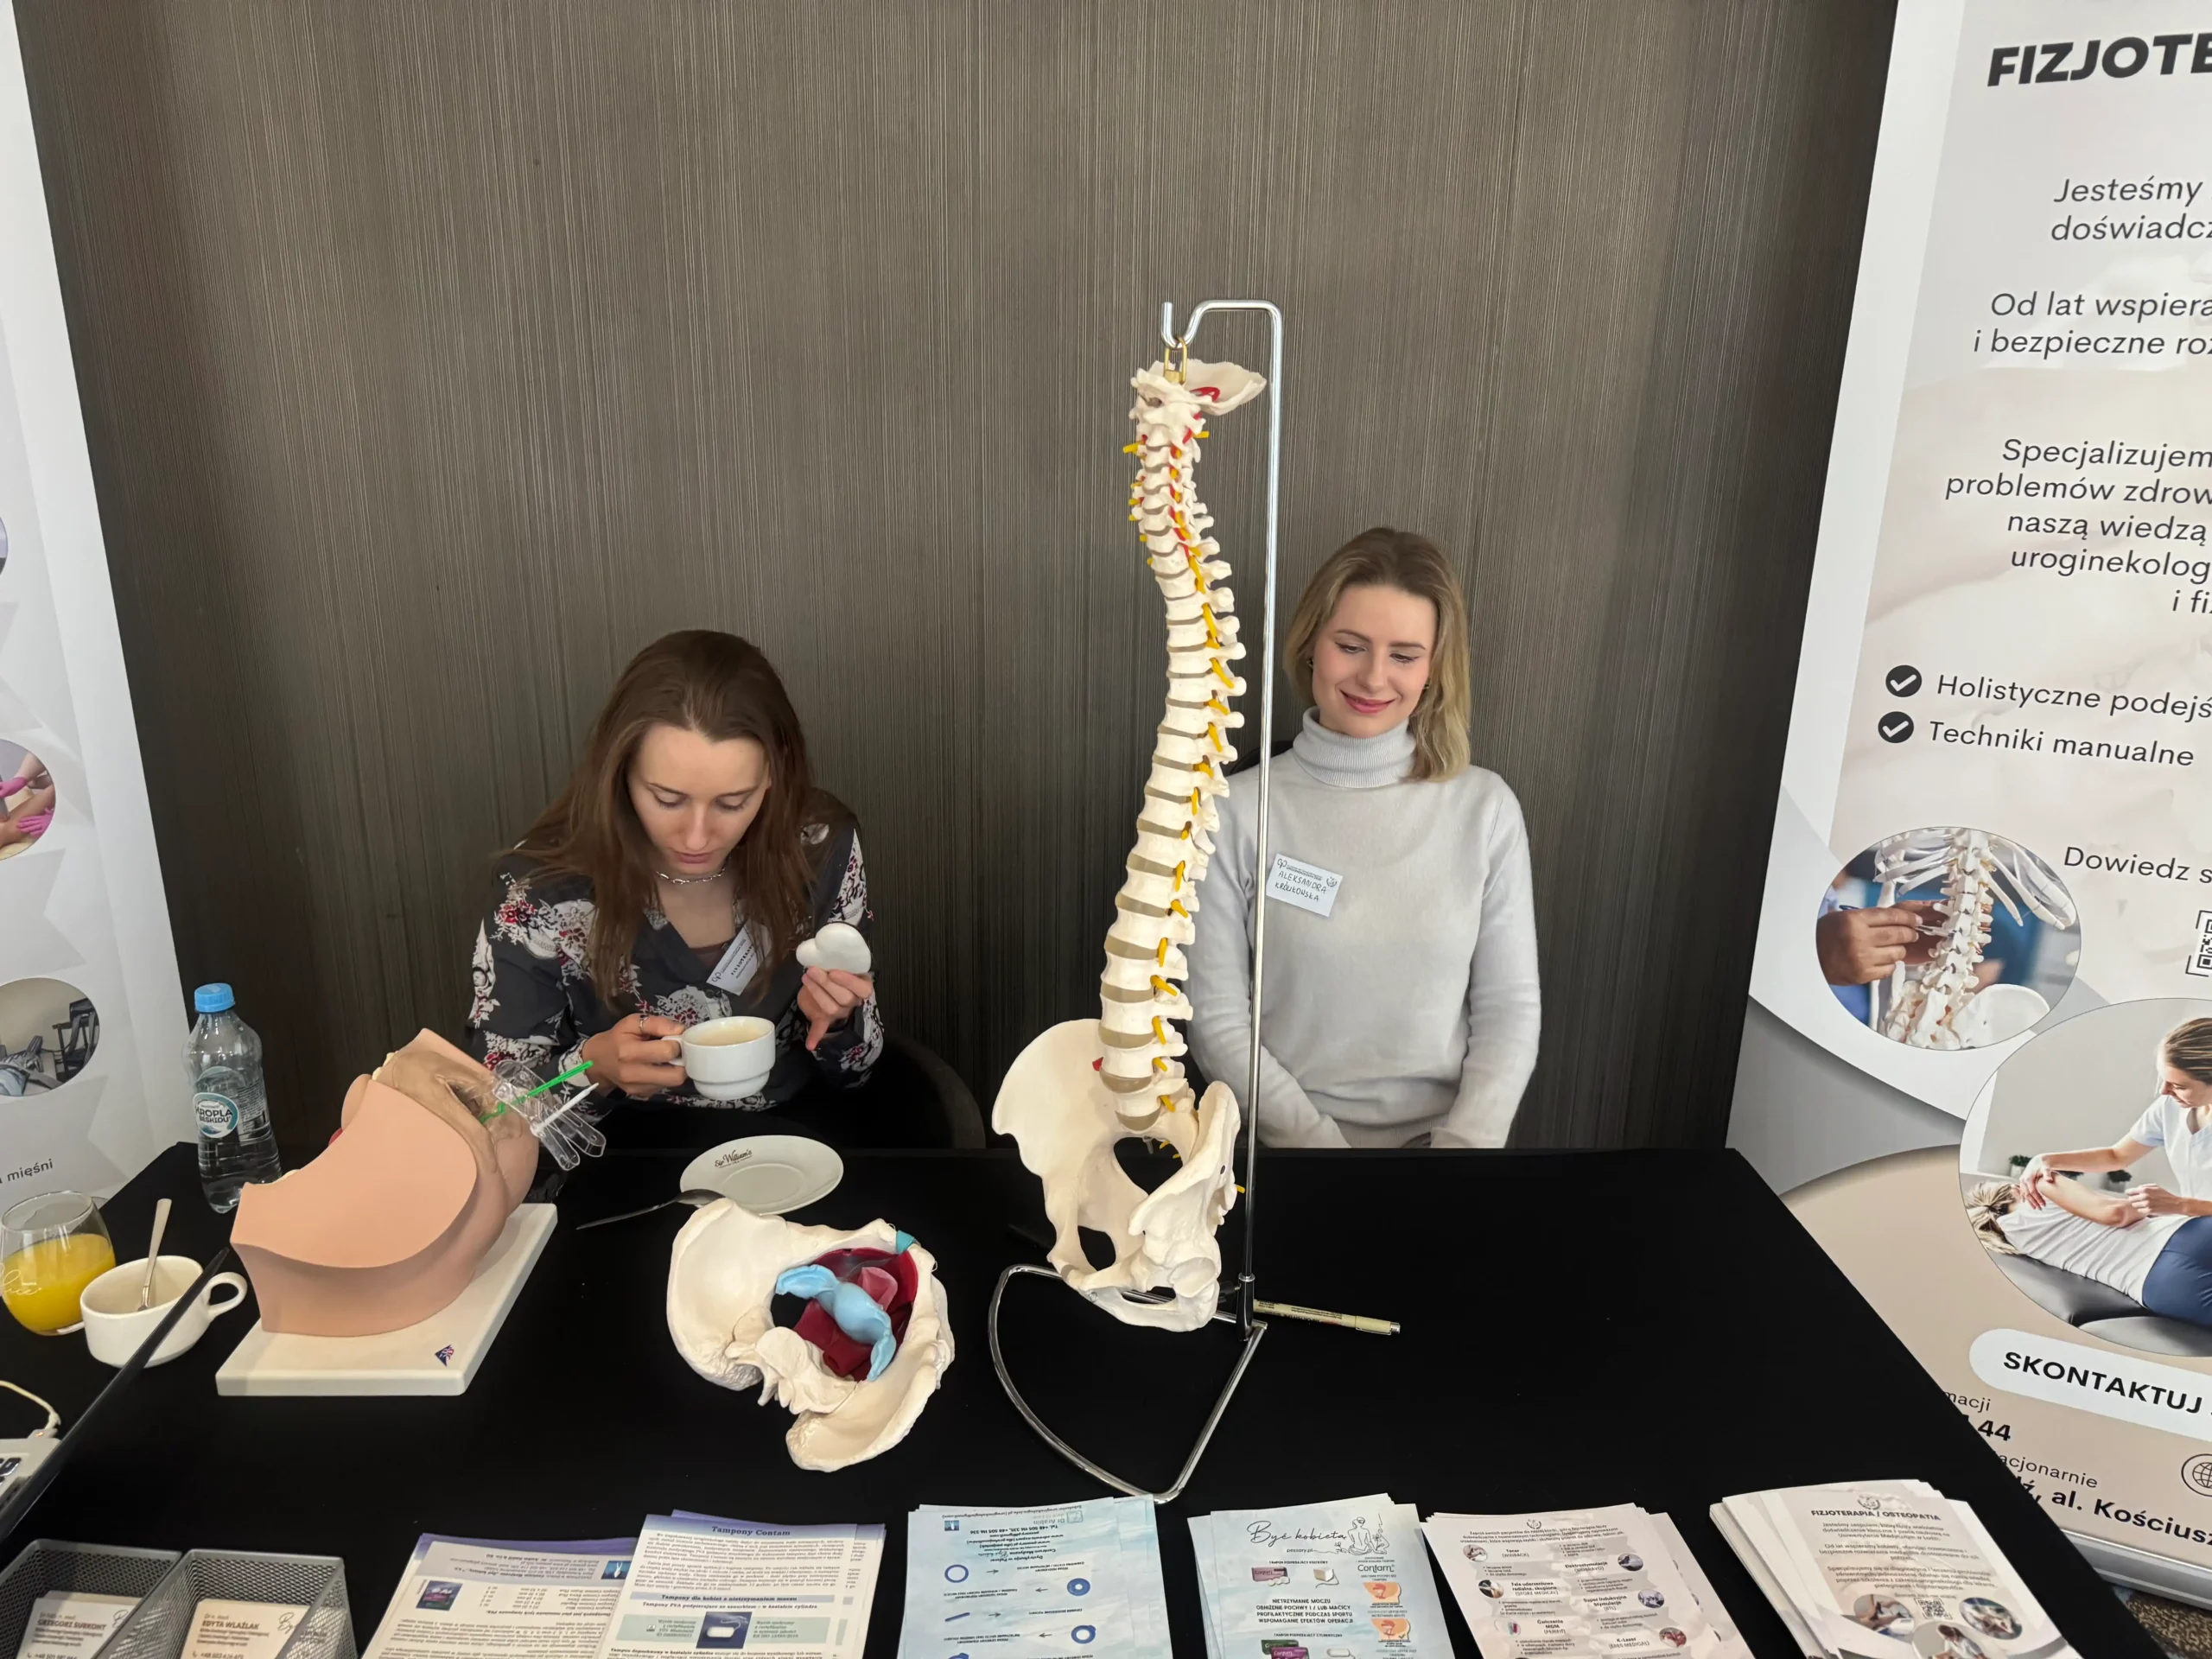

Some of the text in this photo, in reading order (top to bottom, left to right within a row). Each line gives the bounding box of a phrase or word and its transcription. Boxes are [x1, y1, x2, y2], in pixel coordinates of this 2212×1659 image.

[1986, 33, 2212, 87] FIZJOTE
[2053, 175, 2203, 207] Jesteśmy
[1991, 291, 2212, 323] Od lat wspiera
[1974, 329, 1981, 353] i
[1991, 328, 2164, 359] bezpieczne
[2002, 439, 2212, 474] Specjalizujem
[1945, 473, 2212, 505] problemów zdrow
[2007, 515, 2206, 547] naszą wiedzą
[2011, 548, 2211, 585] uroginekolog
[2172, 589, 2212, 614] i fi
[1937, 674, 2212, 724] Holistyczne podejś
[1929, 720, 2195, 766] Techniki manualne
[1278, 870, 1327, 893] ALEKSANDRA
[2063, 846, 2212, 885] Dowiedz s
[7, 1158, 53, 1182] mięśni
[2003, 1351, 2203, 1414] SKONTAKTUJ
[711, 1526, 753, 1535] Tampony
[1882, 1511, 1942, 1521] OSTEOPATIA
[1247, 1521, 1292, 1548] Być
